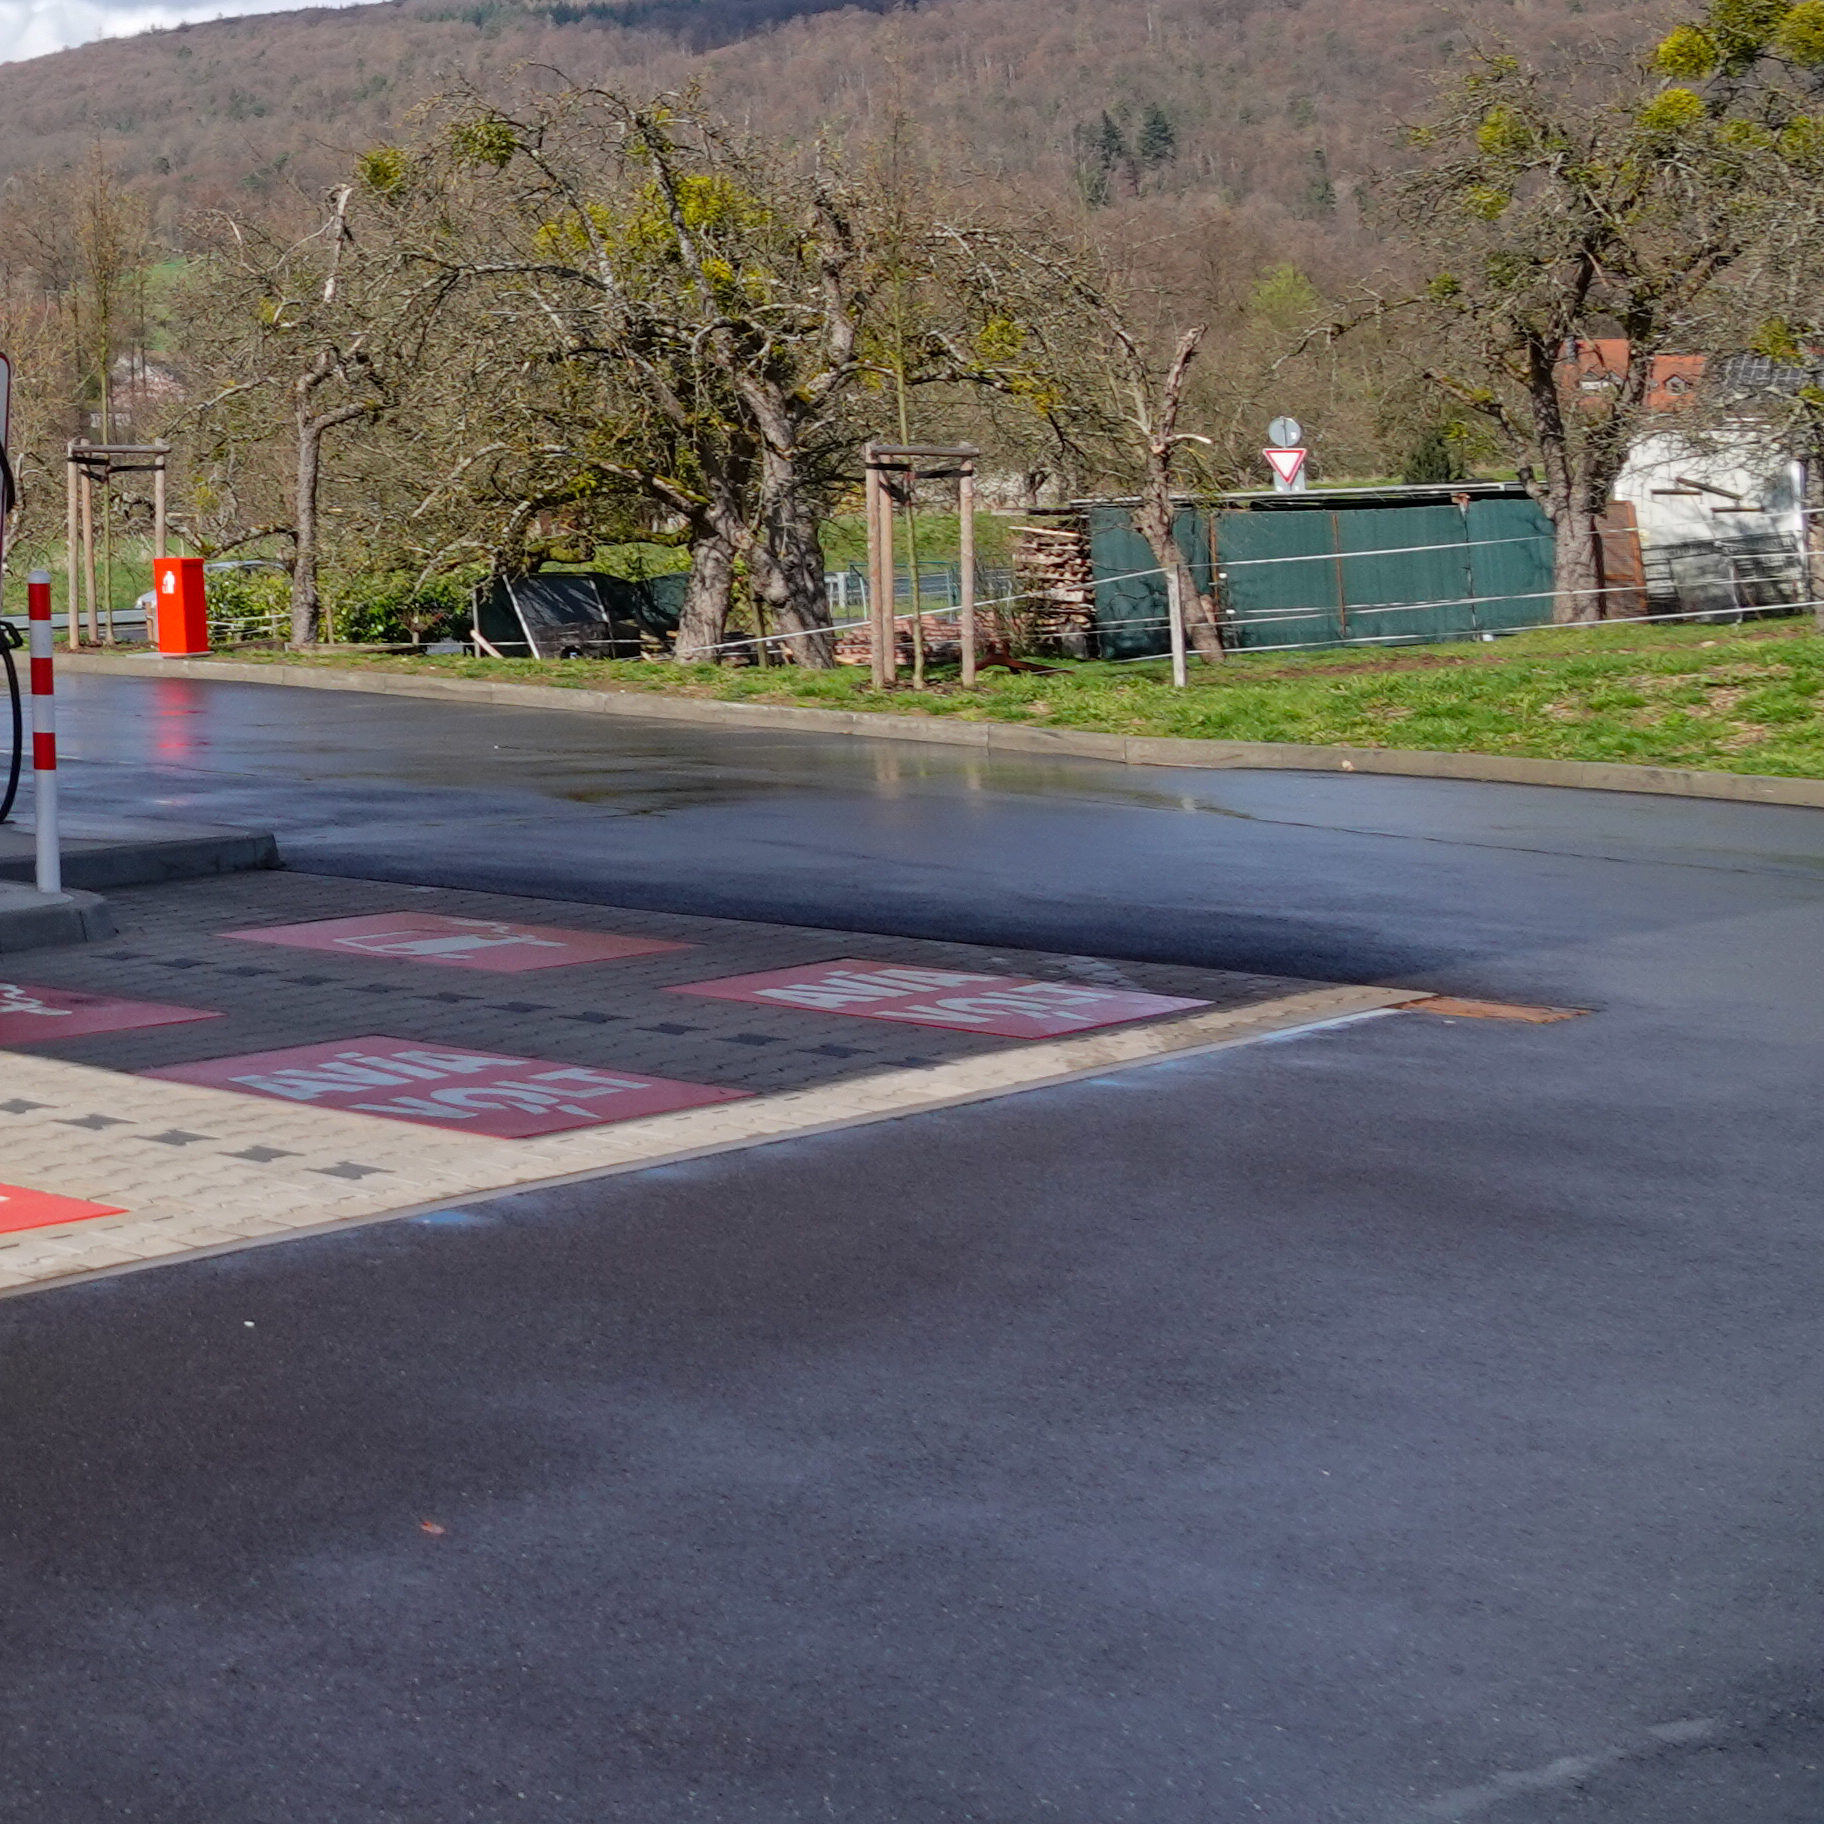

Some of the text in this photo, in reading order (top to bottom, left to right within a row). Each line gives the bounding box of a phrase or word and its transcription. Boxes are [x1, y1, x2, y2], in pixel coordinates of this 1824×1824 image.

[751, 968, 1003, 1009] AVIA
[872, 982, 1117, 1024] VOLT
[227, 1049, 533, 1101] AVIA
[349, 1064, 652, 1120] VOLT
